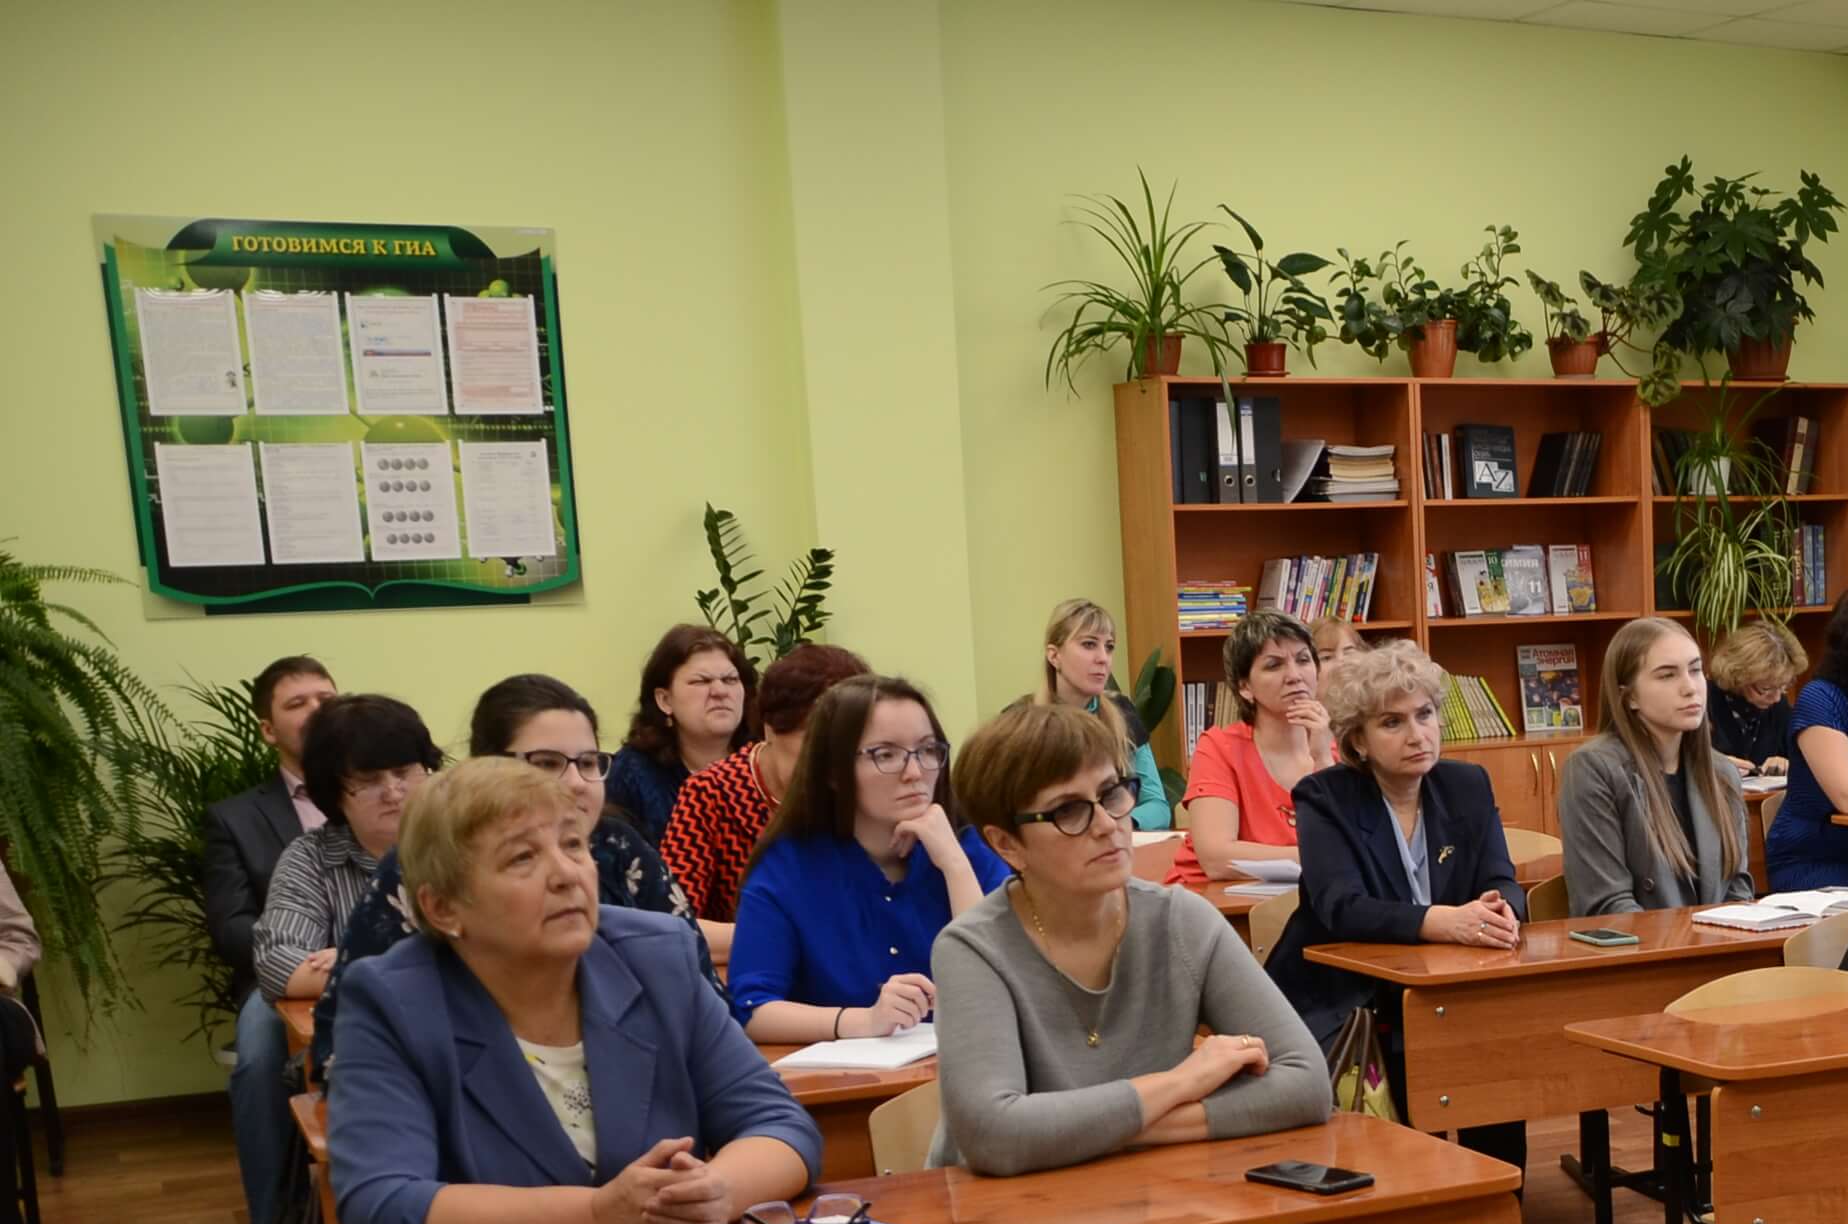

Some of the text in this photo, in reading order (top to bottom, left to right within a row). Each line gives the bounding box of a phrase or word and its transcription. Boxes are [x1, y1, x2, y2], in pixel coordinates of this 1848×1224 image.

[231, 235, 437, 256] ГОТОВИМСЯ К ГИА
[1528, 580, 1541, 593] 11
